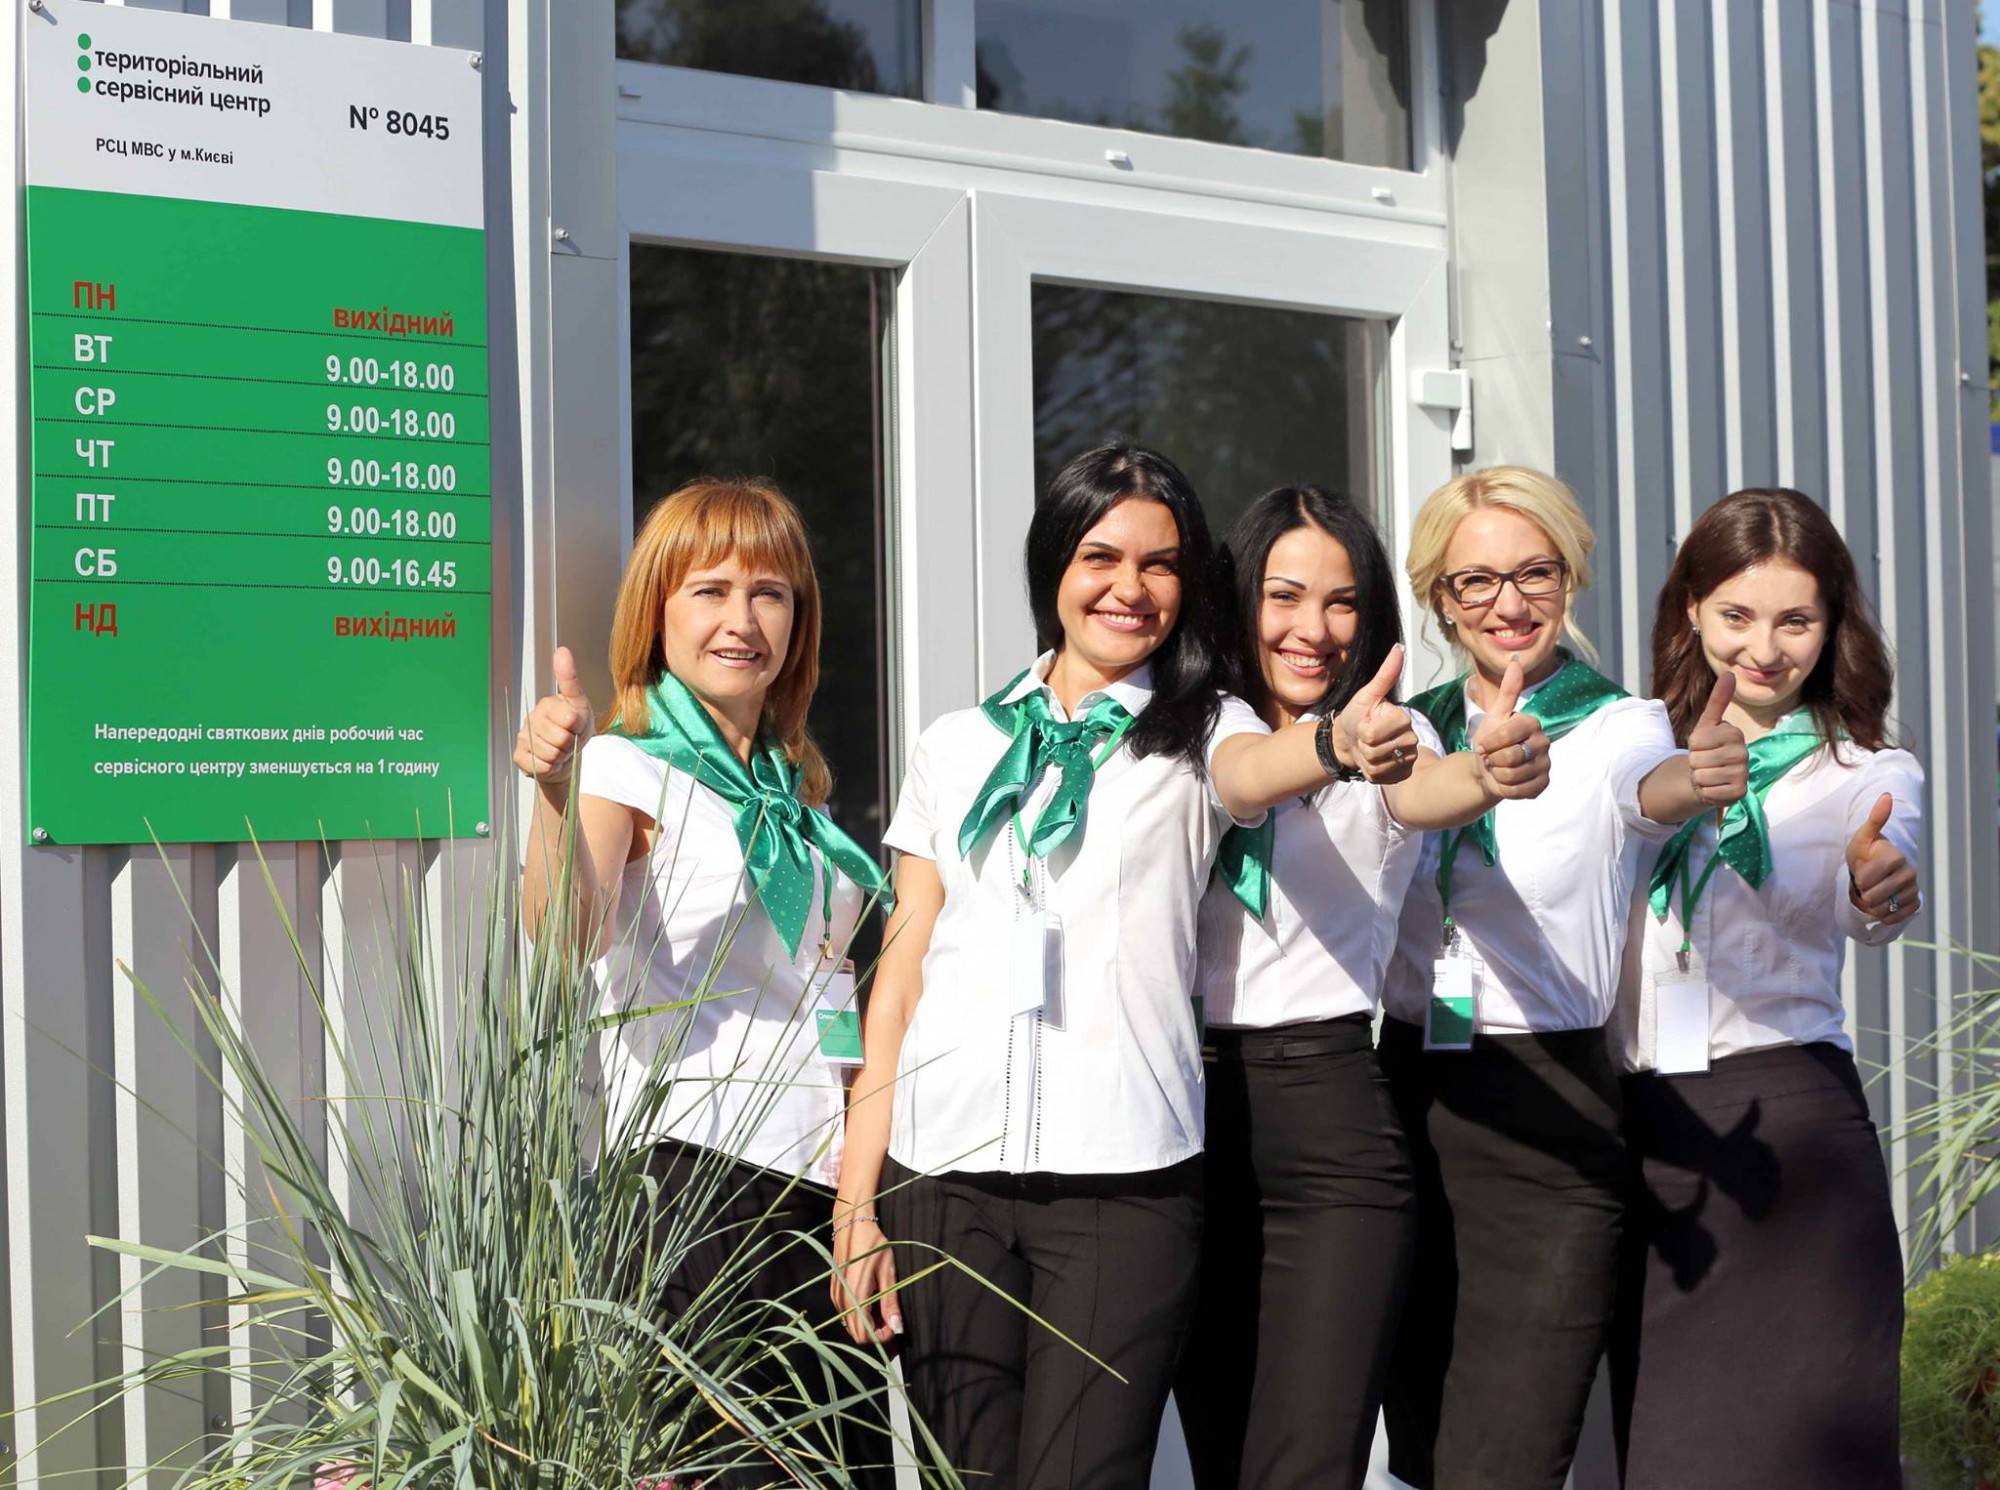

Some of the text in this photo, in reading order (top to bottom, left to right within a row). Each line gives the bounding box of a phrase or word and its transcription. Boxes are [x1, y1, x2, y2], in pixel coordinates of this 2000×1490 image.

[94, 50, 263, 85] територіальний
[95, 79, 271, 118] сервісний центр
[386, 109, 450, 141] 8045
[96, 137, 234, 165] РСЦ МВС у м.Києві
[73, 280, 454, 338] ПН вихідний
[74, 333, 455, 392] ВТ 9.00-18.00
[74, 386, 456, 439] СР 9.00-18.00
[75, 438, 456, 492] ЧТ 9.00-18.00
[76, 493, 457, 539] ПТ 9.00-18.00
[74, 547, 457, 588] СБ 9.00-16.45
[74, 602, 456, 641] НД вихідний
[94, 723, 424, 744] Напередодні святкових днів робочий час
[94, 757, 440, 778] сервісного центру зменшується на 1 годину
